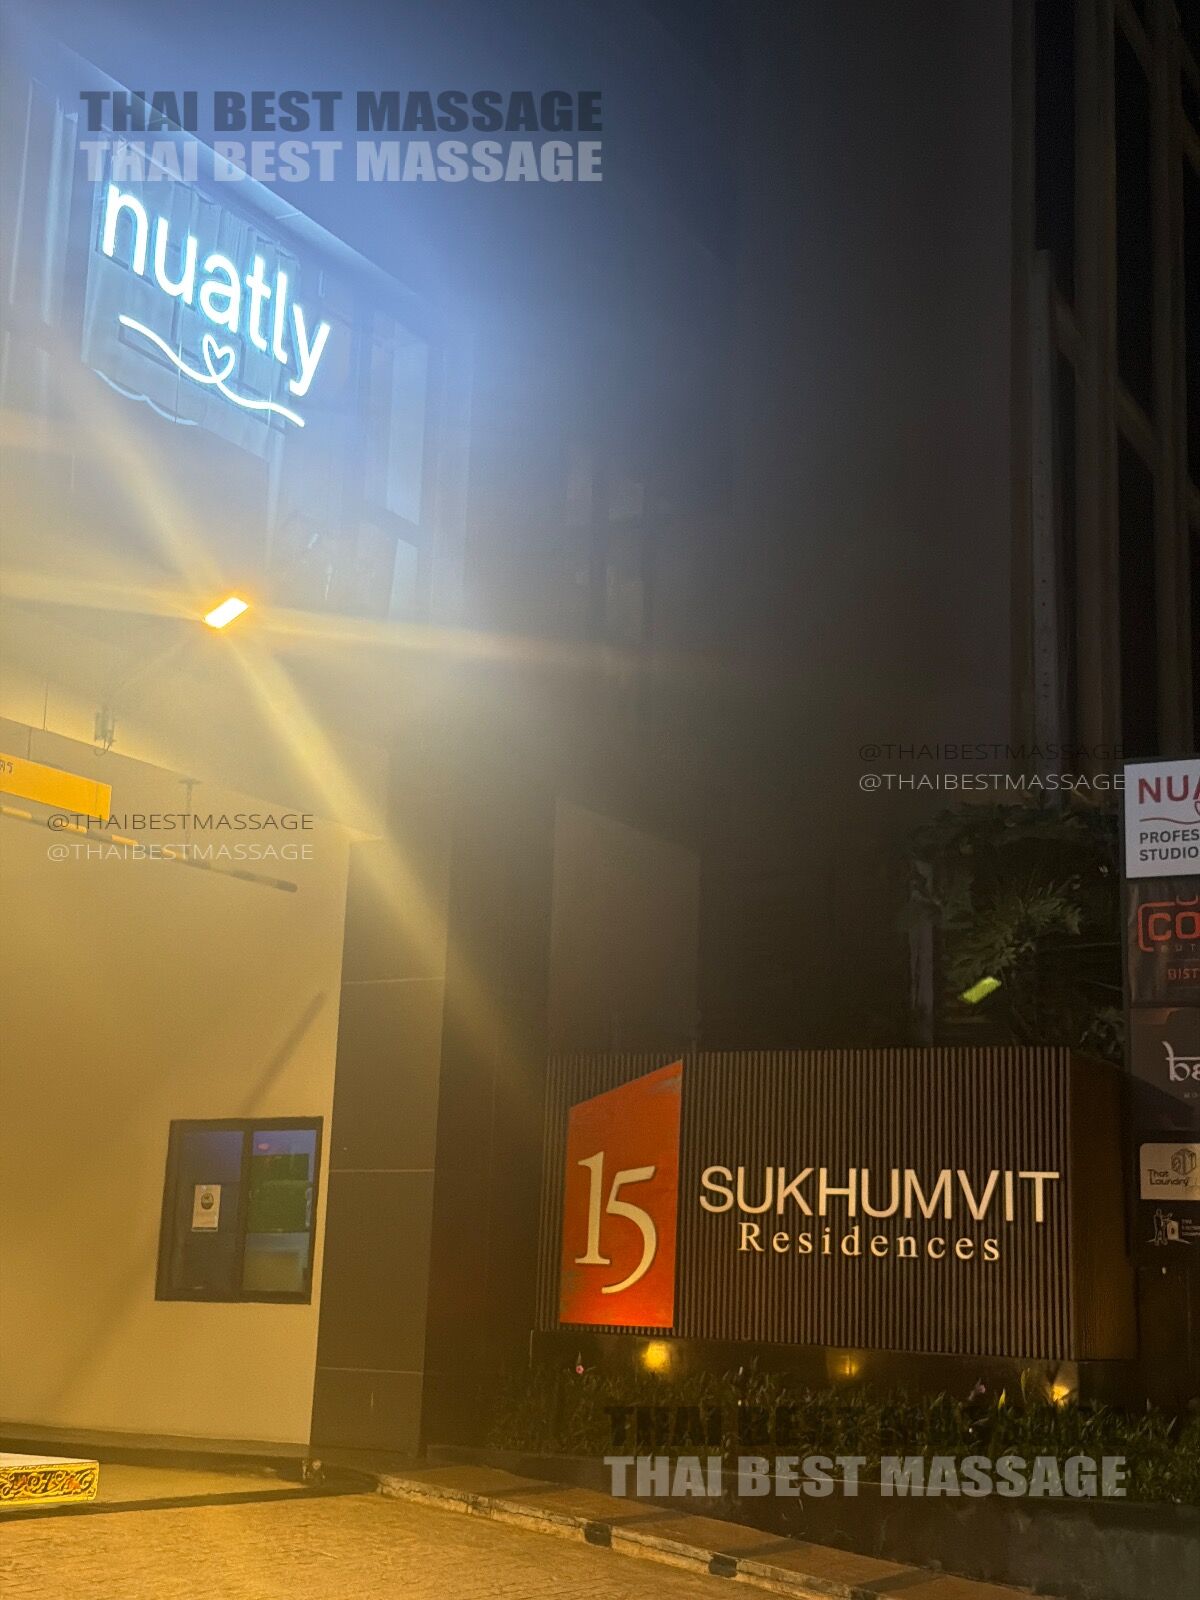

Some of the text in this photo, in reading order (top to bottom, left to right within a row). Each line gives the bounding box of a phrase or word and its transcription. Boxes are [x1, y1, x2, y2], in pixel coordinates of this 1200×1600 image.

[103, 183, 331, 397] nuatly
[1139, 845, 1199, 861] STUDIO
[575, 1150, 657, 1294] 15
[699, 1165, 1061, 1223] SUKHUMVIT
[737, 1222, 1001, 1262] Residences
